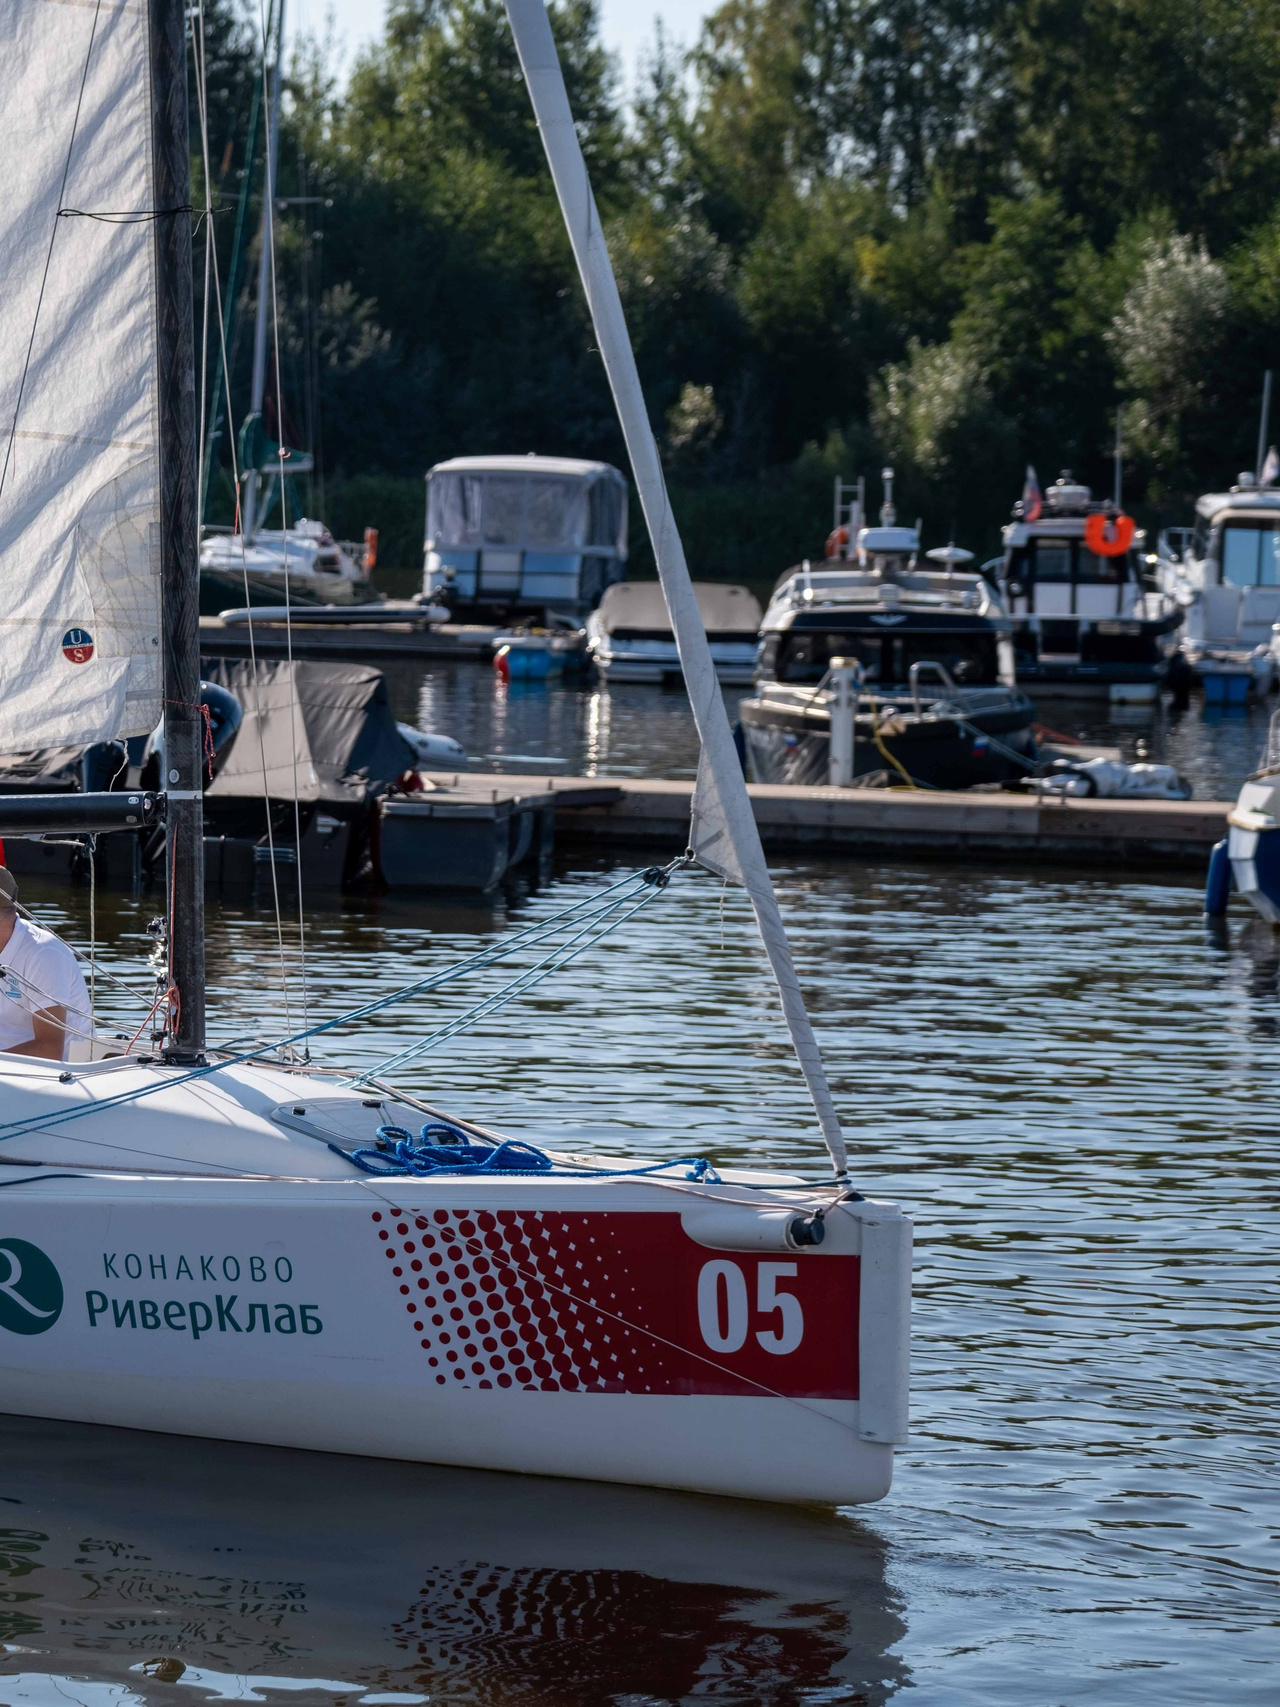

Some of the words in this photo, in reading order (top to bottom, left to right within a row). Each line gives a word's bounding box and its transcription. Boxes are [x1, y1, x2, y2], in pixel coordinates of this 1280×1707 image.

[70, 630, 82, 645] U
[73, 648, 85, 662] S
[102, 1252, 294, 1284] КОНАКОВО
[84, 1290, 324, 1341] РиверКлаб
[697, 1258, 804, 1355] 05
